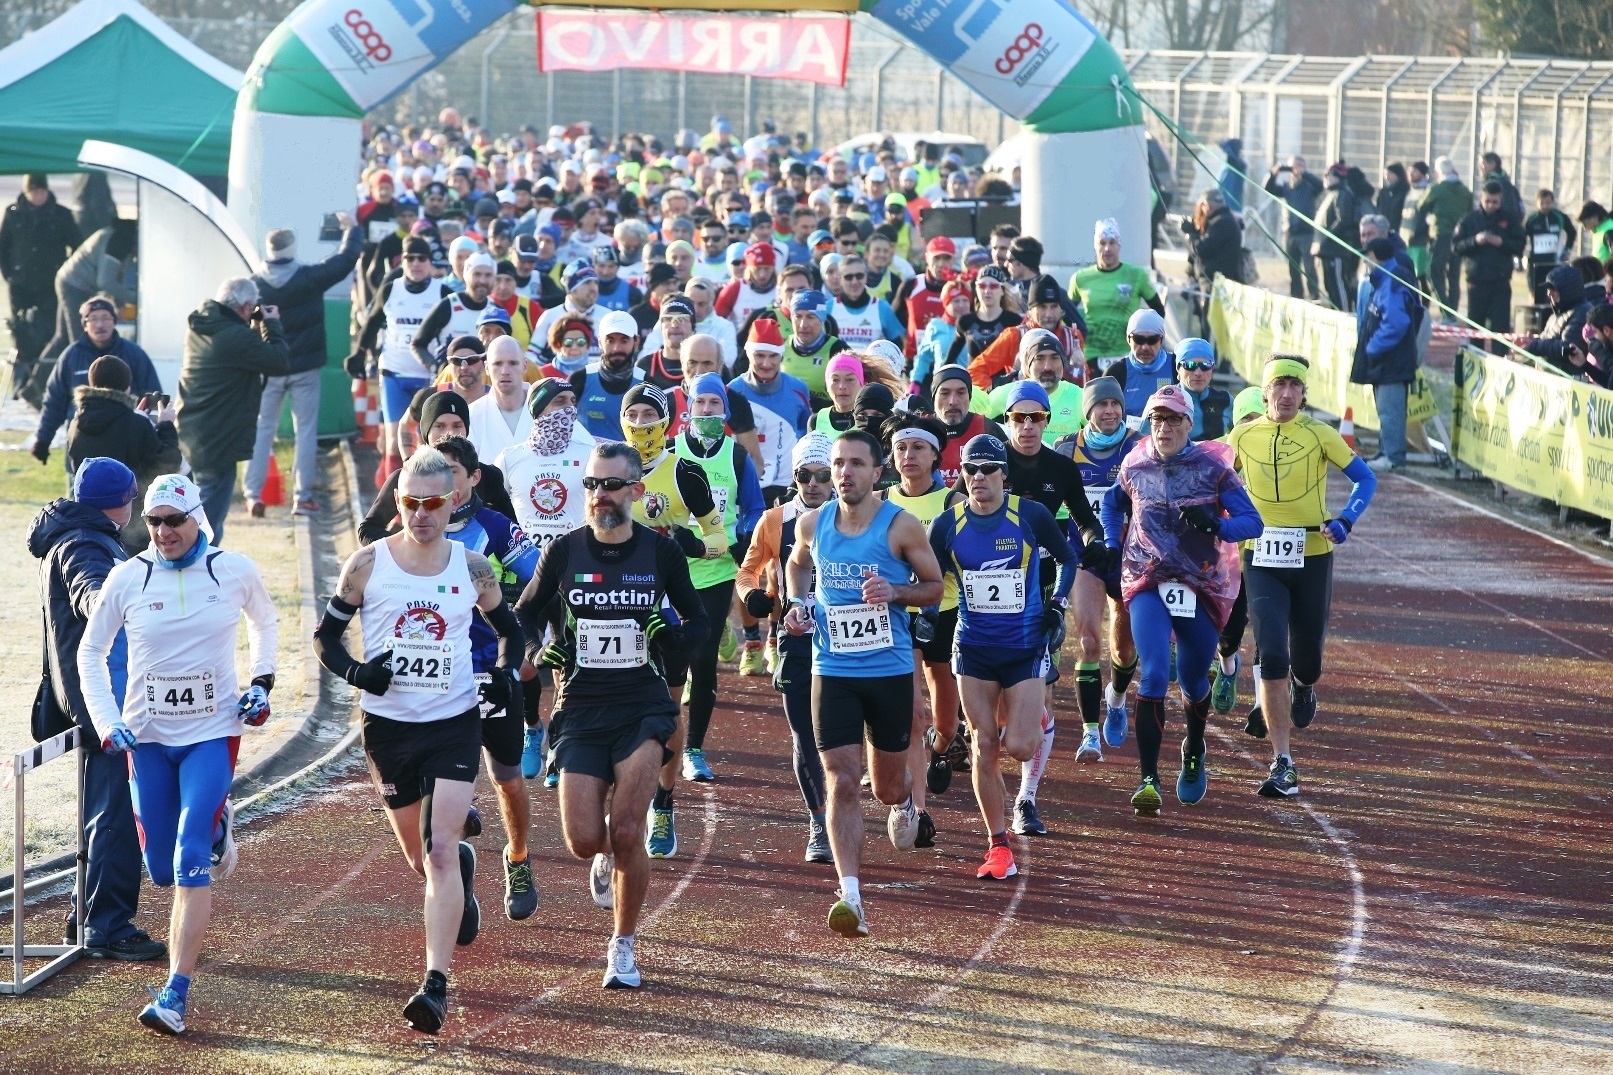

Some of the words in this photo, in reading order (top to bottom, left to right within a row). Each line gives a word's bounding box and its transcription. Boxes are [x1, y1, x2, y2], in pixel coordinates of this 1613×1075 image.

[344, 9, 392, 62] coop
[995, 22, 1044, 74] coop
[534, 472, 561, 481] PASSO
[535, 509, 566, 520] CAPPONI
[1265, 540, 1293, 556] 119
[622, 573, 655, 582] italsoft
[568, 588, 655, 606] Grottini
[988, 585, 1000, 601] 2
[1165, 589, 1184, 605] 61
[406, 600, 440, 611] PASSO
[840, 618, 877, 639] 124
[598, 636, 621, 654] 71
[395, 656, 439, 678] 242
[164, 687, 195, 707] 44
